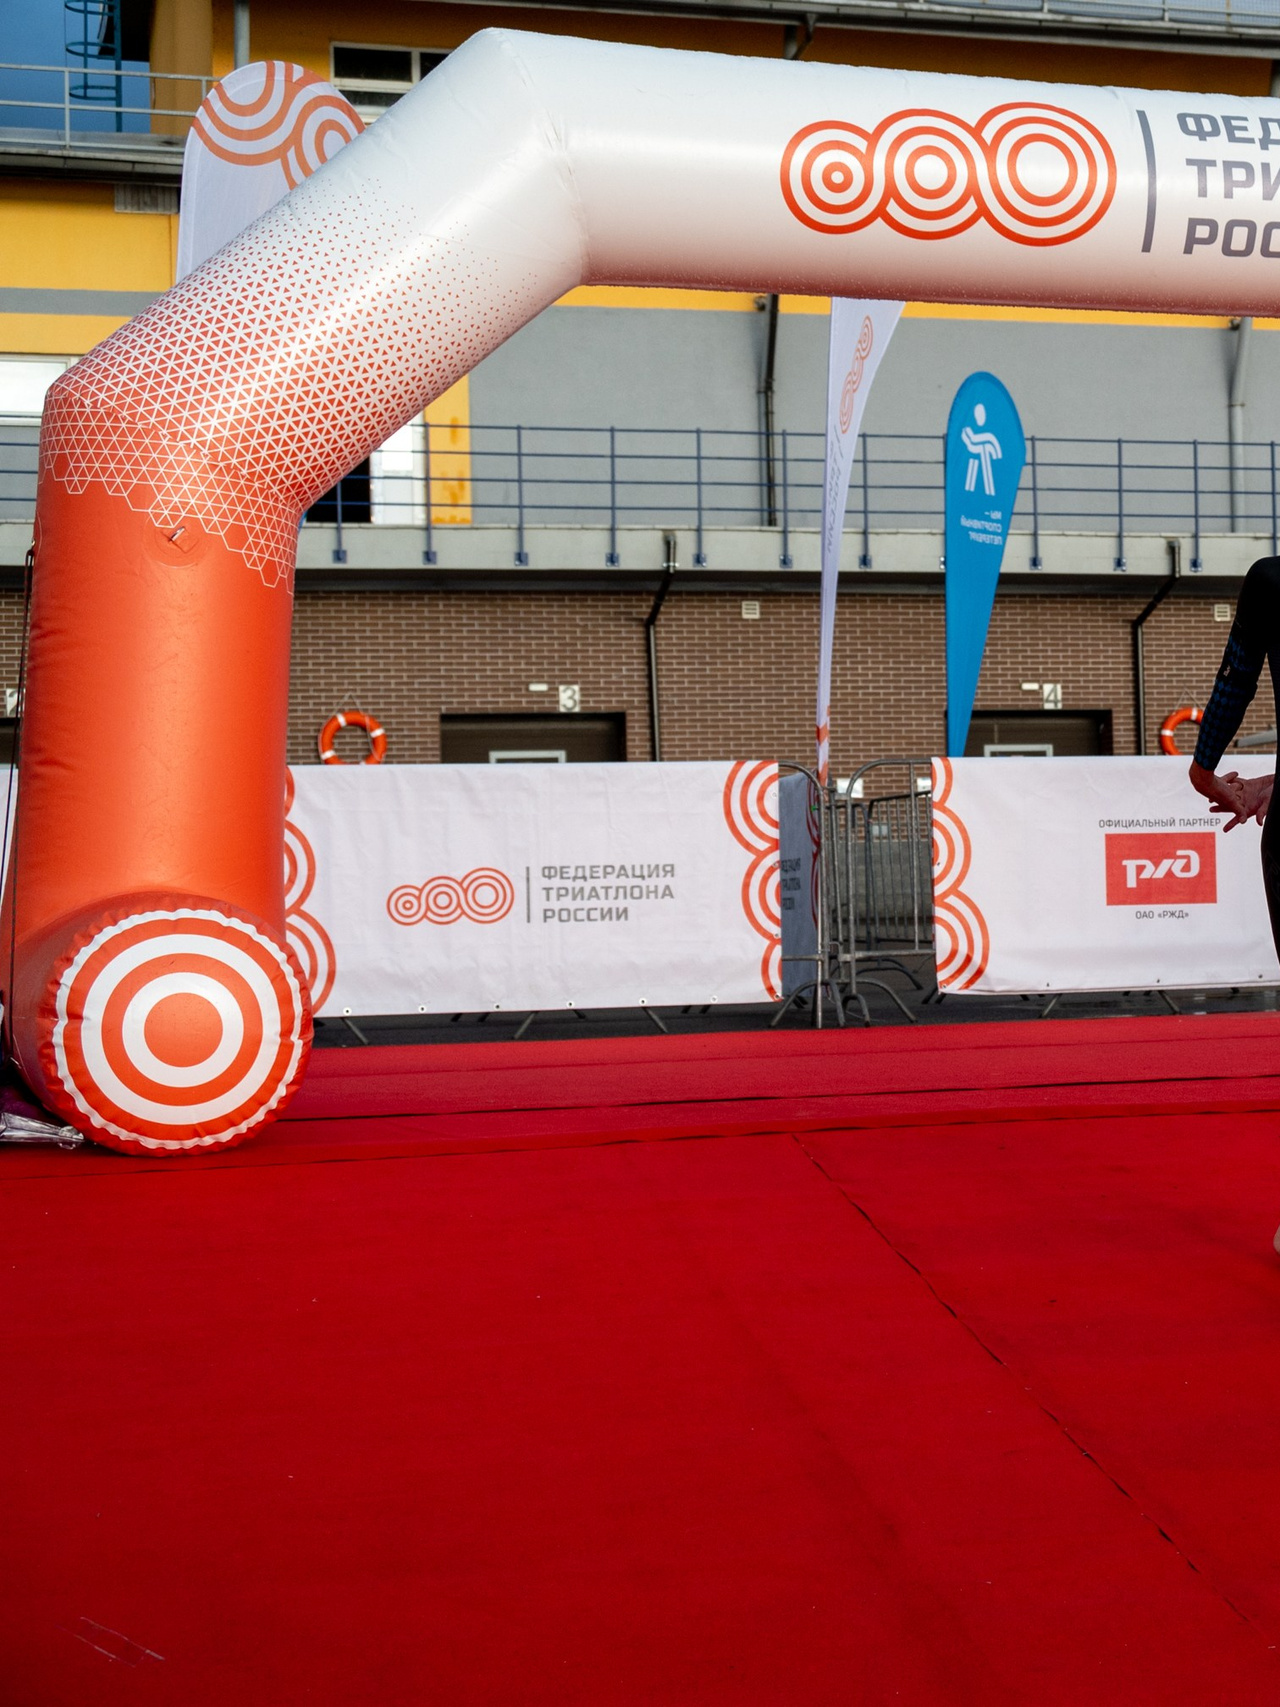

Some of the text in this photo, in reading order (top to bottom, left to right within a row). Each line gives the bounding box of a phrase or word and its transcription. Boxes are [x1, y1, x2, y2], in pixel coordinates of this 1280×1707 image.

[562, 686, 577, 711] 3
[1044, 684, 1062, 709] 4
[1098, 817, 1221, 829] ОФИЦИАЛЬНЫЙ ПАРТНЕР
[541, 863, 676, 882] ФЕДЕРАЦИЯ
[541, 884, 676, 902] ТРИАТЛОНА
[542, 906, 629, 923] РОССИИ
[1135, 909, 1189, 920] ОАО «РЖД»
